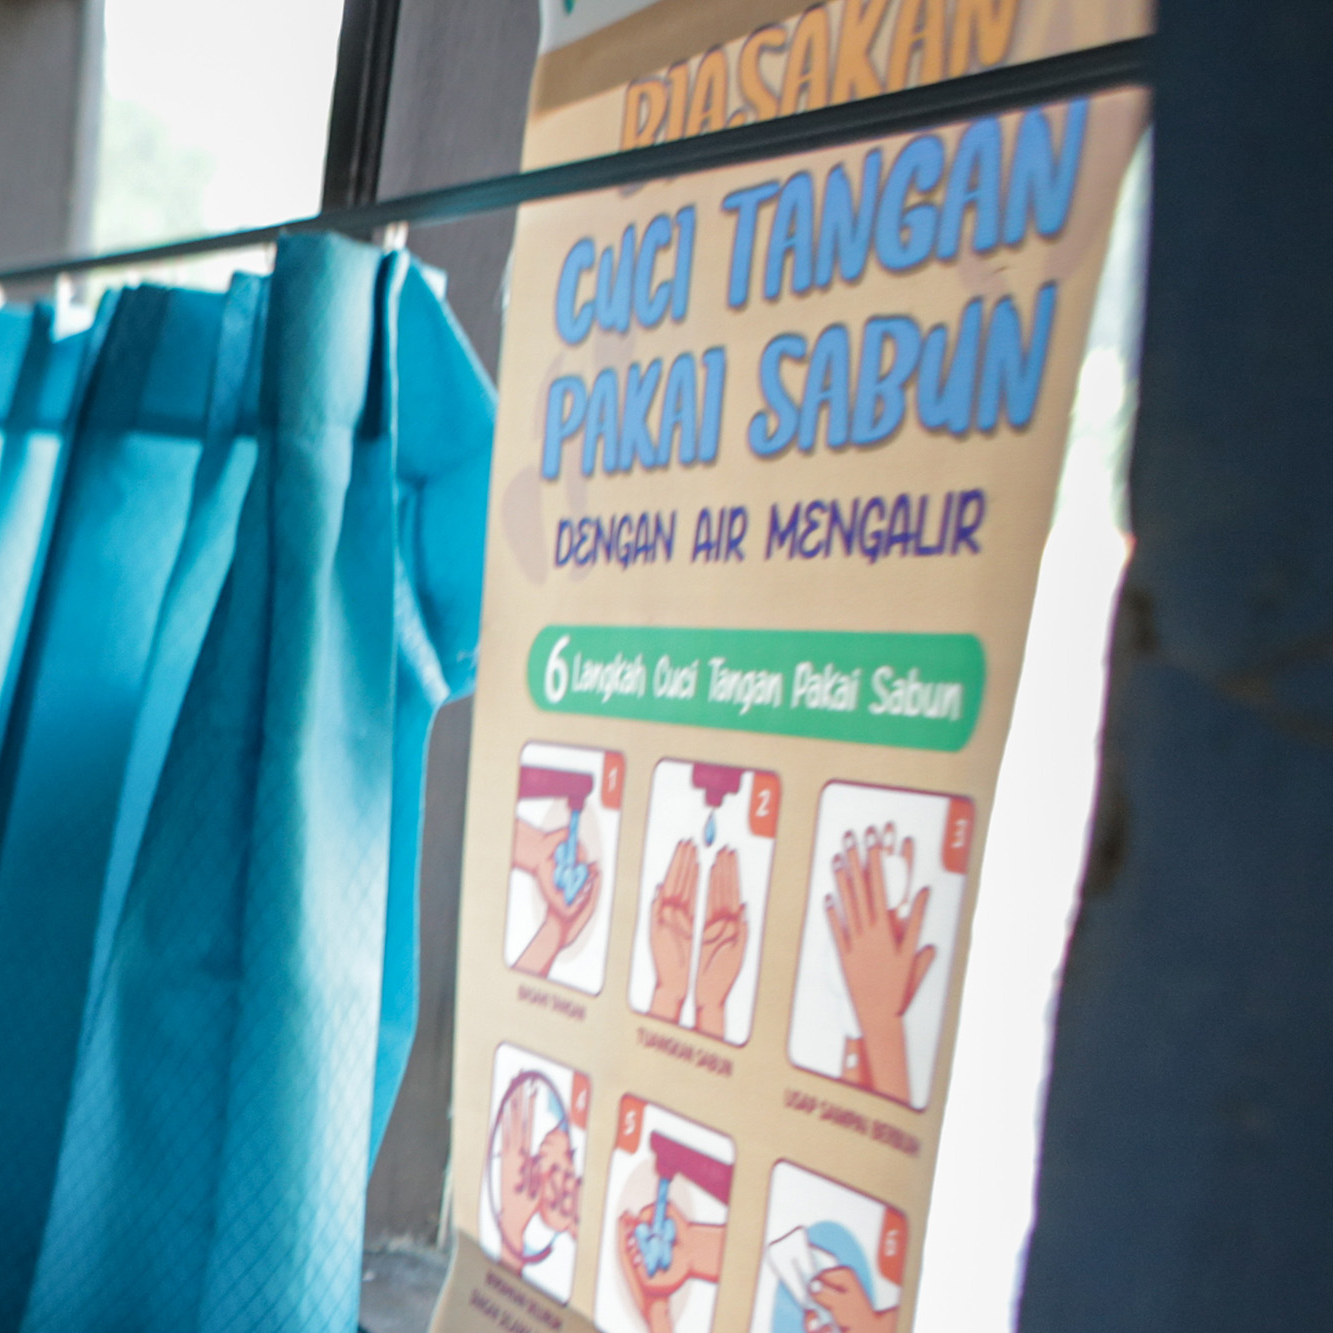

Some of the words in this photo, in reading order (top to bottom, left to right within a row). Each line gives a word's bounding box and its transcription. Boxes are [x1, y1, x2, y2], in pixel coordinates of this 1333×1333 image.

[554, 203, 696, 347] CUCI
[722, 97, 1091, 311] TANGAN
[540, 346, 726, 482] PAKAI
[747, 281, 1058, 459] SABUN
[554, 511, 677, 570] DENGAN
[692, 503, 747, 562] AIR
[765, 489, 988, 566] MENGALIR
[543, 634, 570, 704] 6
[572, 652, 647, 703] Langkah
[653, 655, 699, 699] Cuci
[708, 656, 784, 715] Tangan
[790, 661, 862, 712] Pakai
[868, 665, 963, 721] Sabun
[608, 767, 618, 792] 1
[755, 791, 771, 817] 2
[952, 817, 969, 849] 3
[623, 1108, 635, 1135] 5
